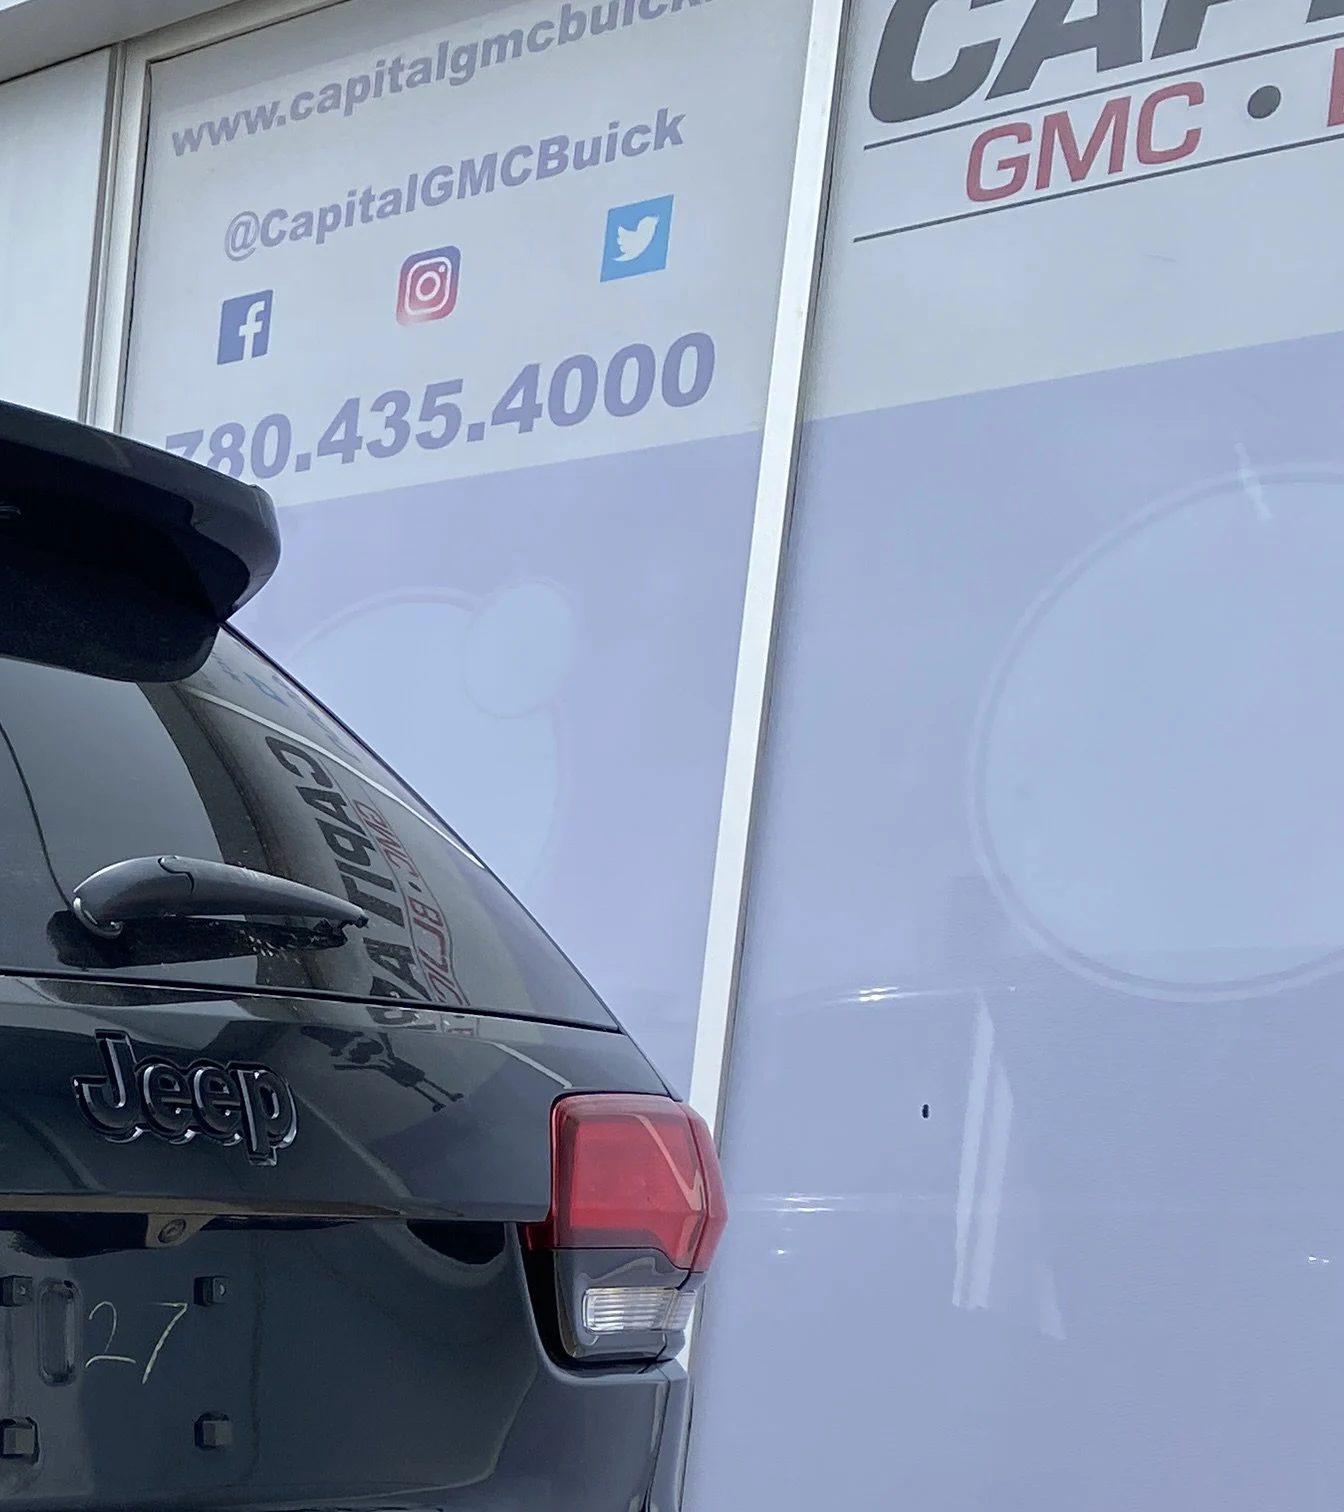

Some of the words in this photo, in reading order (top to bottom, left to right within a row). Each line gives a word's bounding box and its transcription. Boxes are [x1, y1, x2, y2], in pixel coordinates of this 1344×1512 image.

[171, 0, 709, 157] www.capitalgmcbuic
[965, 80, 1205, 203] GMC
[224, 107, 687, 262] @CapitalGMCBuick
[71, 1029, 300, 1168] Jeep
[84, 1300, 189, 1385] 27
